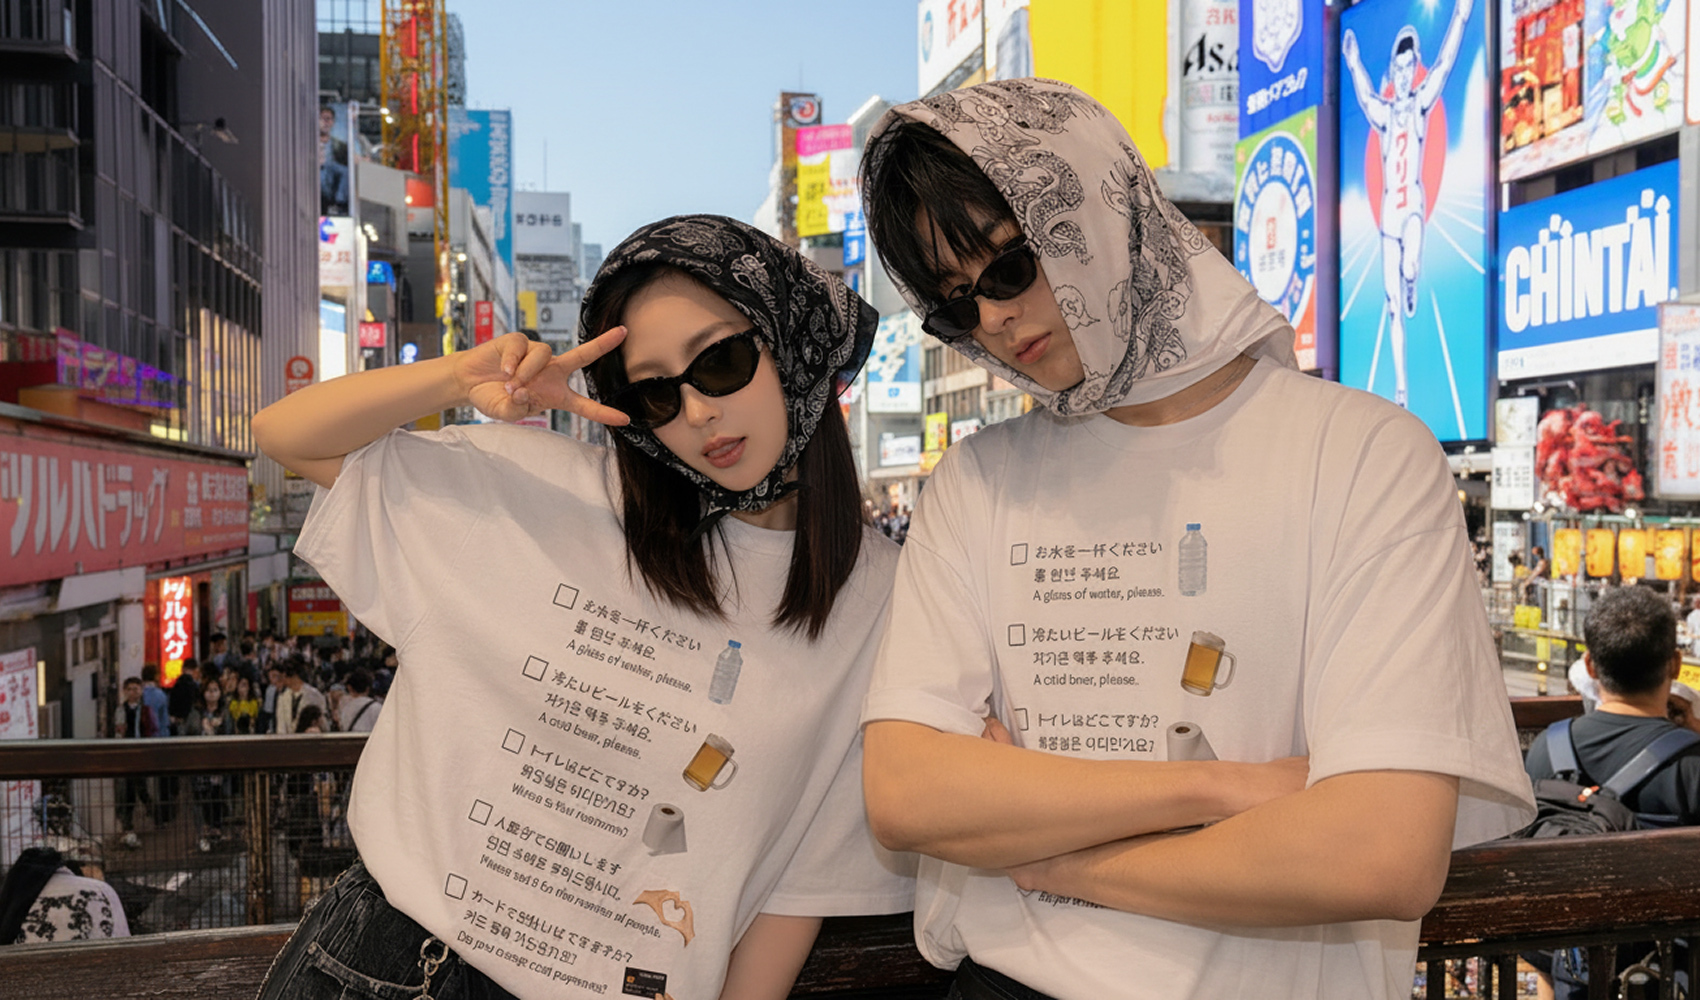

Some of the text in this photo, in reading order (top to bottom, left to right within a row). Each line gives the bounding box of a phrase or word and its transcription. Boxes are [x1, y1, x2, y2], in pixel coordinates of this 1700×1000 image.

[1033, 590, 1041, 601] A
[1074, 587, 1087, 600] of
[565, 638, 575, 650] A
[1033, 674, 1041, 685] A
[537, 711, 546, 723] A
